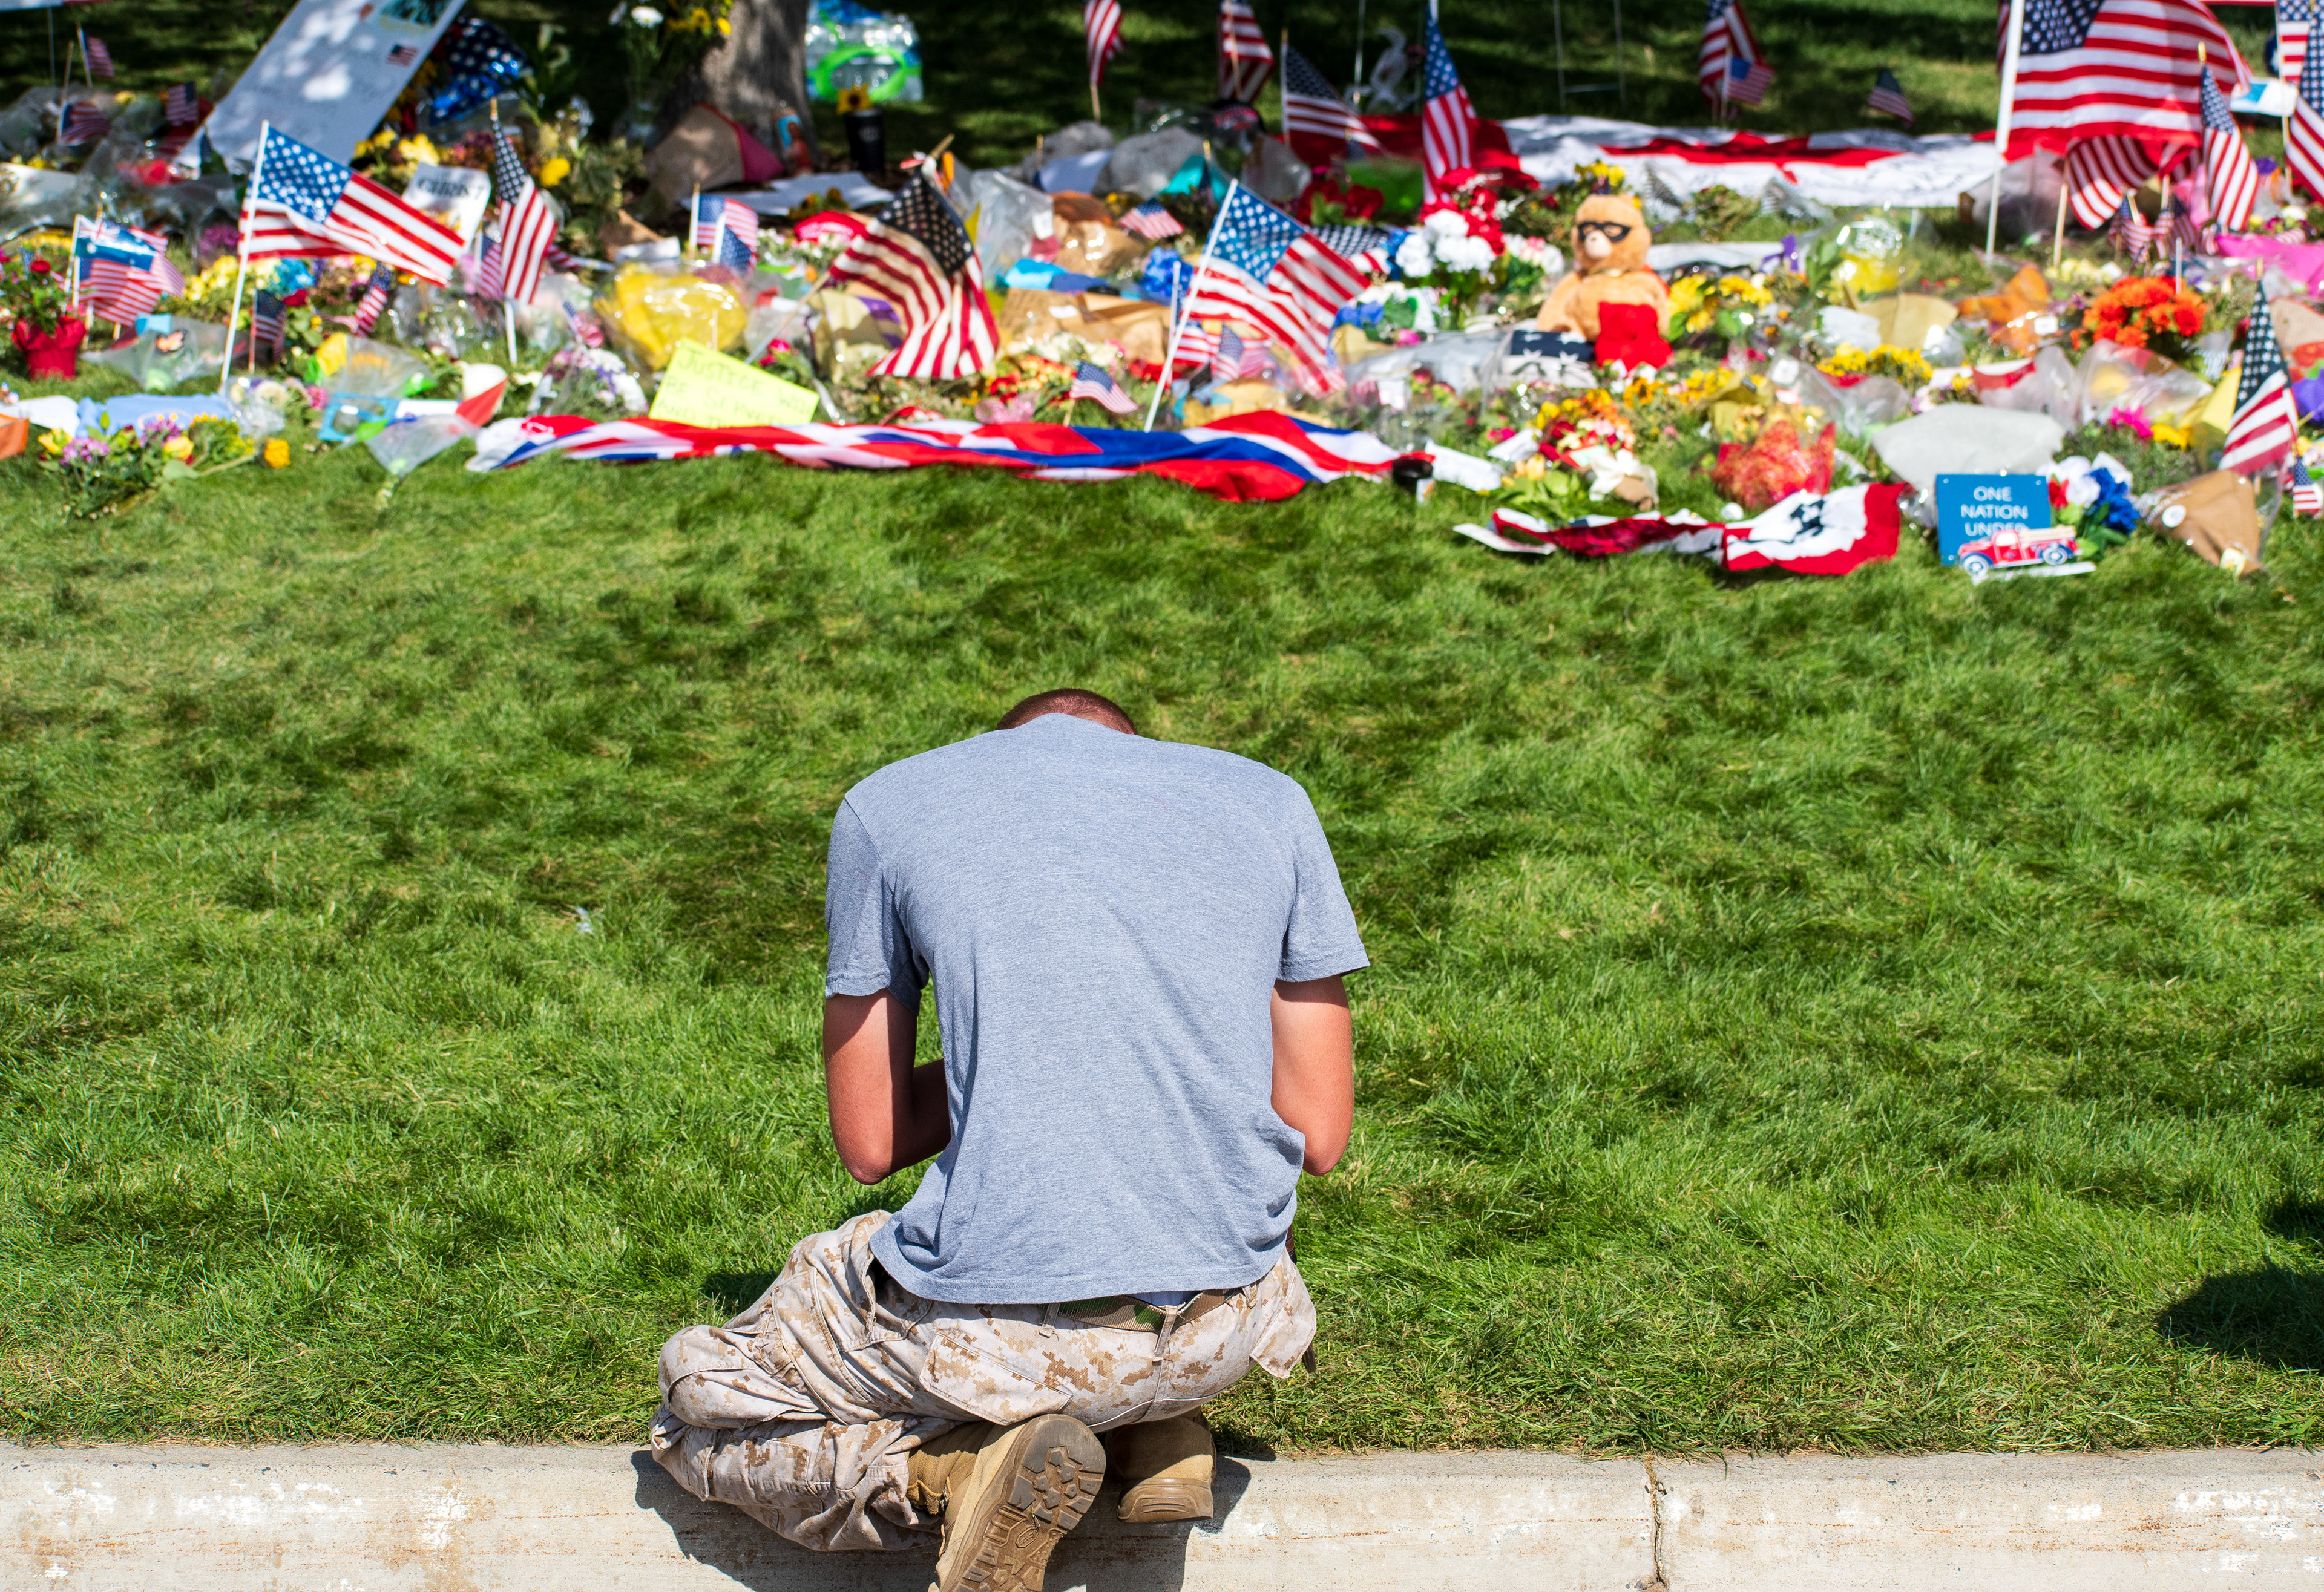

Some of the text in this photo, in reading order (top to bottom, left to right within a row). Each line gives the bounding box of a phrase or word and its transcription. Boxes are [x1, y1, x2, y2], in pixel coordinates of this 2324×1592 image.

[676, 347, 765, 396] JUSTICE
[665, 374, 690, 401] BE
[1973, 486, 2013, 502] ONE
[1960, 504, 2029, 520] NATION
